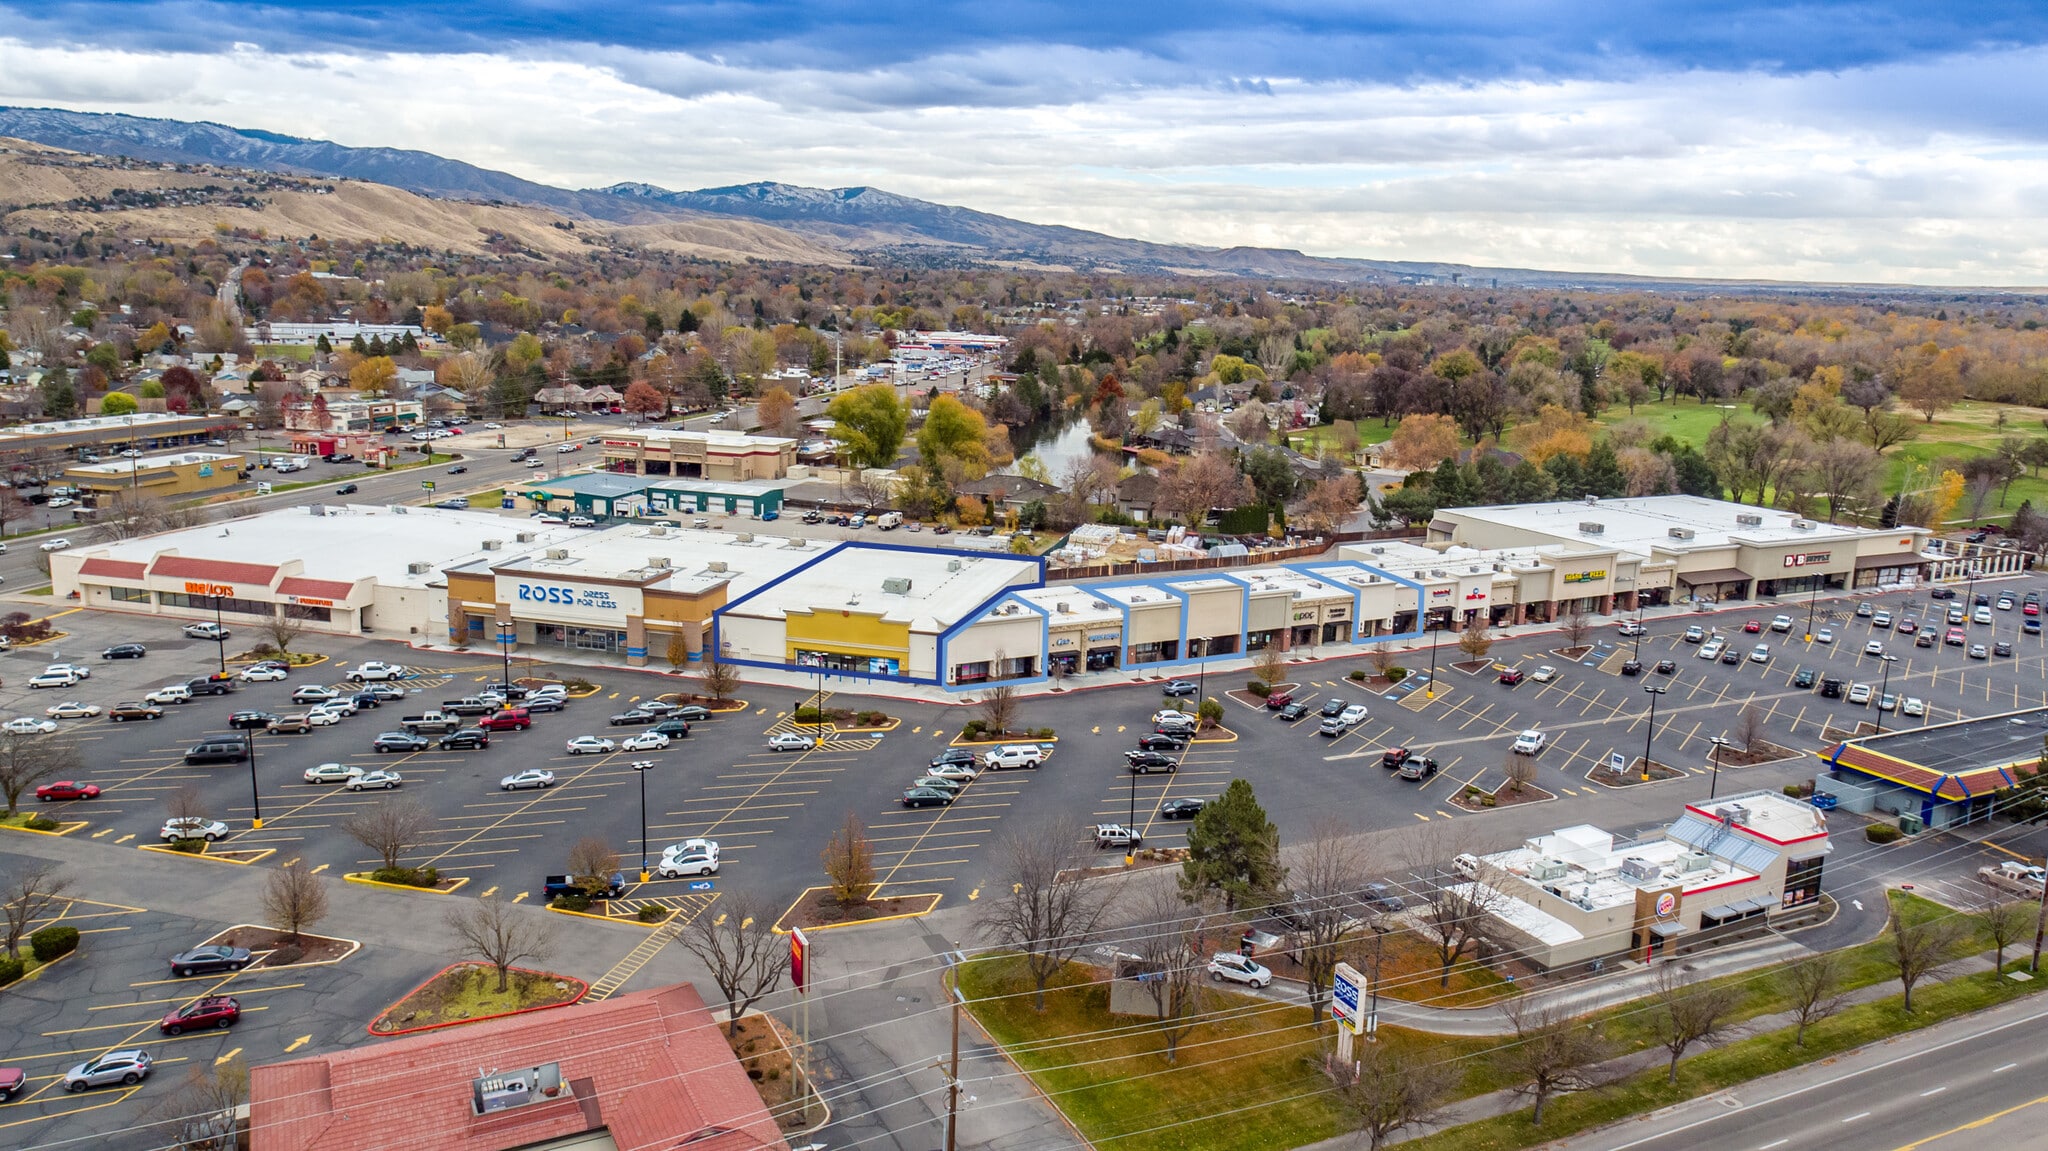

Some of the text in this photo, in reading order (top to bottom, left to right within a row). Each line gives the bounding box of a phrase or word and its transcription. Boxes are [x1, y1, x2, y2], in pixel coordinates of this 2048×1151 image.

[519, 584, 573, 605] ROSS
[583, 590, 610, 600] DRESS
[576, 598, 617, 609] FOR LESS
[1335, 977, 1358, 1001] ROSS
